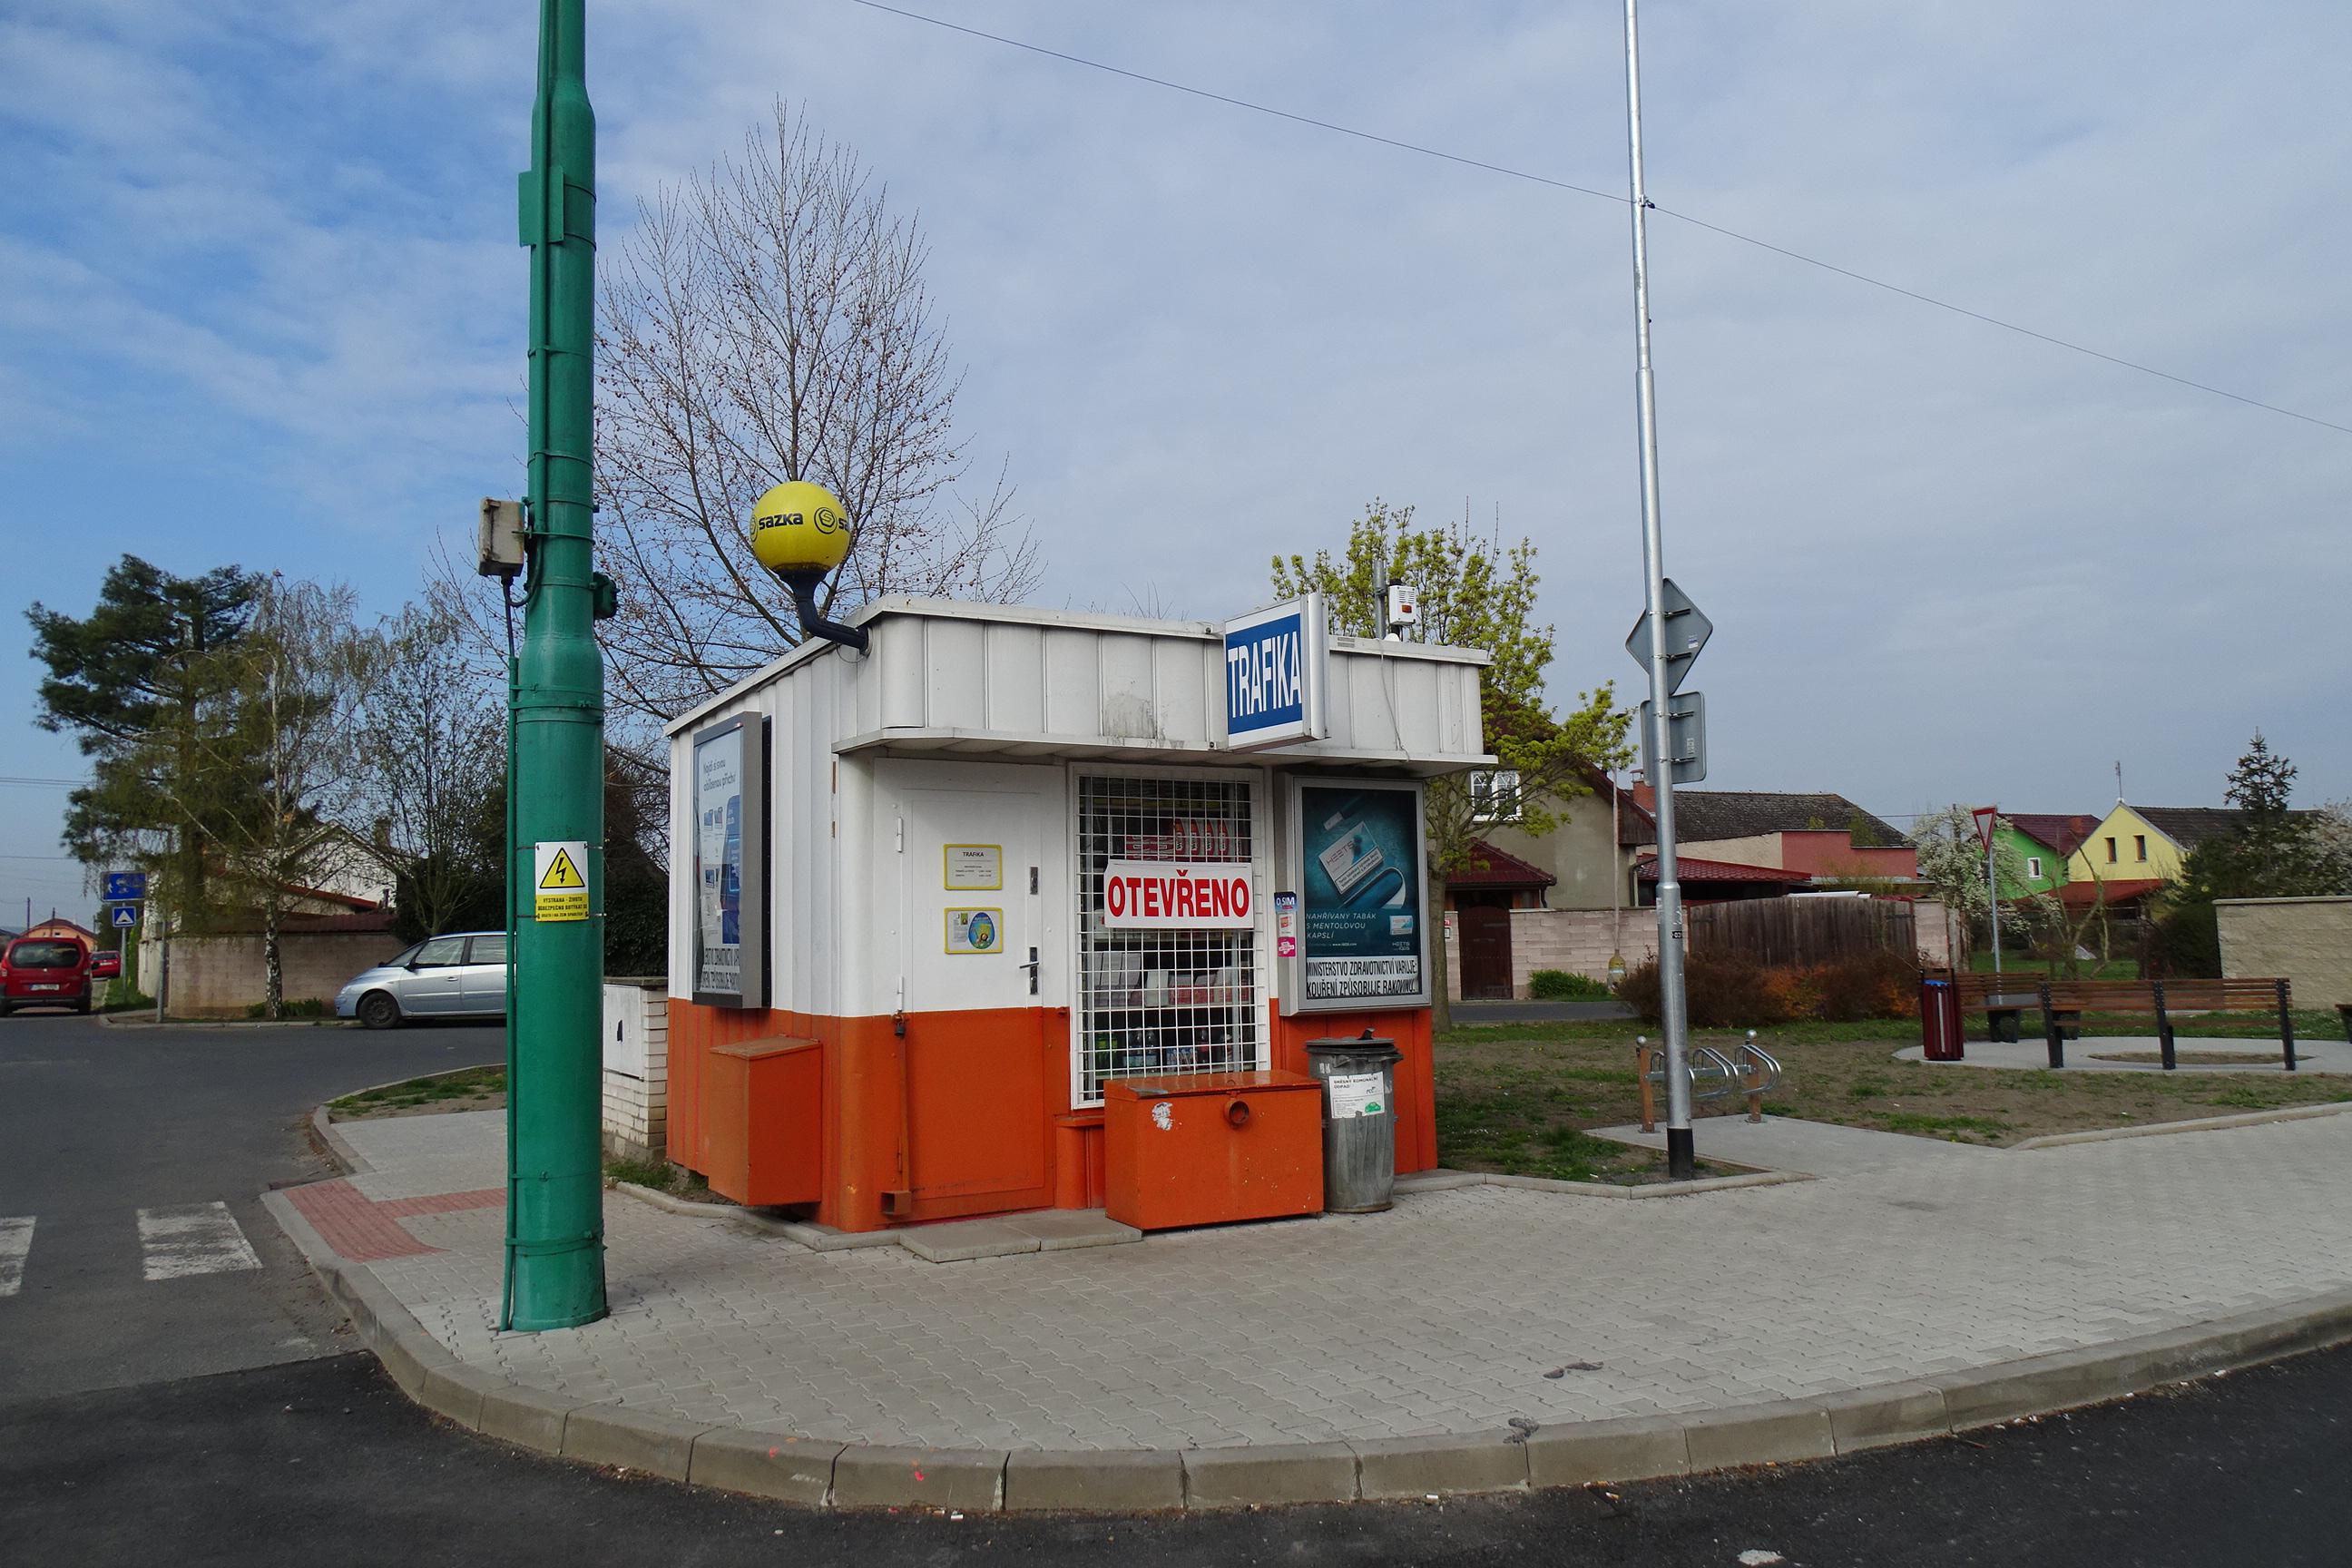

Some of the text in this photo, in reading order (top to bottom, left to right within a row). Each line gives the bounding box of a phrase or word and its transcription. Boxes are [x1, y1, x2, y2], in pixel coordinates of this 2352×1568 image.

[759, 513, 803, 530] sazka
[1228, 632, 1302, 718] TRAFIKA
[1108, 869, 1249, 917] OTEVŘENO
[1307, 961, 1348, 976] MINISTERSTVO
[1349, 958, 1395, 975] ZDRAVOTNICTVÍ
[1307, 979, 1338, 996] KOUŘENÍ
[1339, 978, 1380, 995] ZPŮSOBUJE
